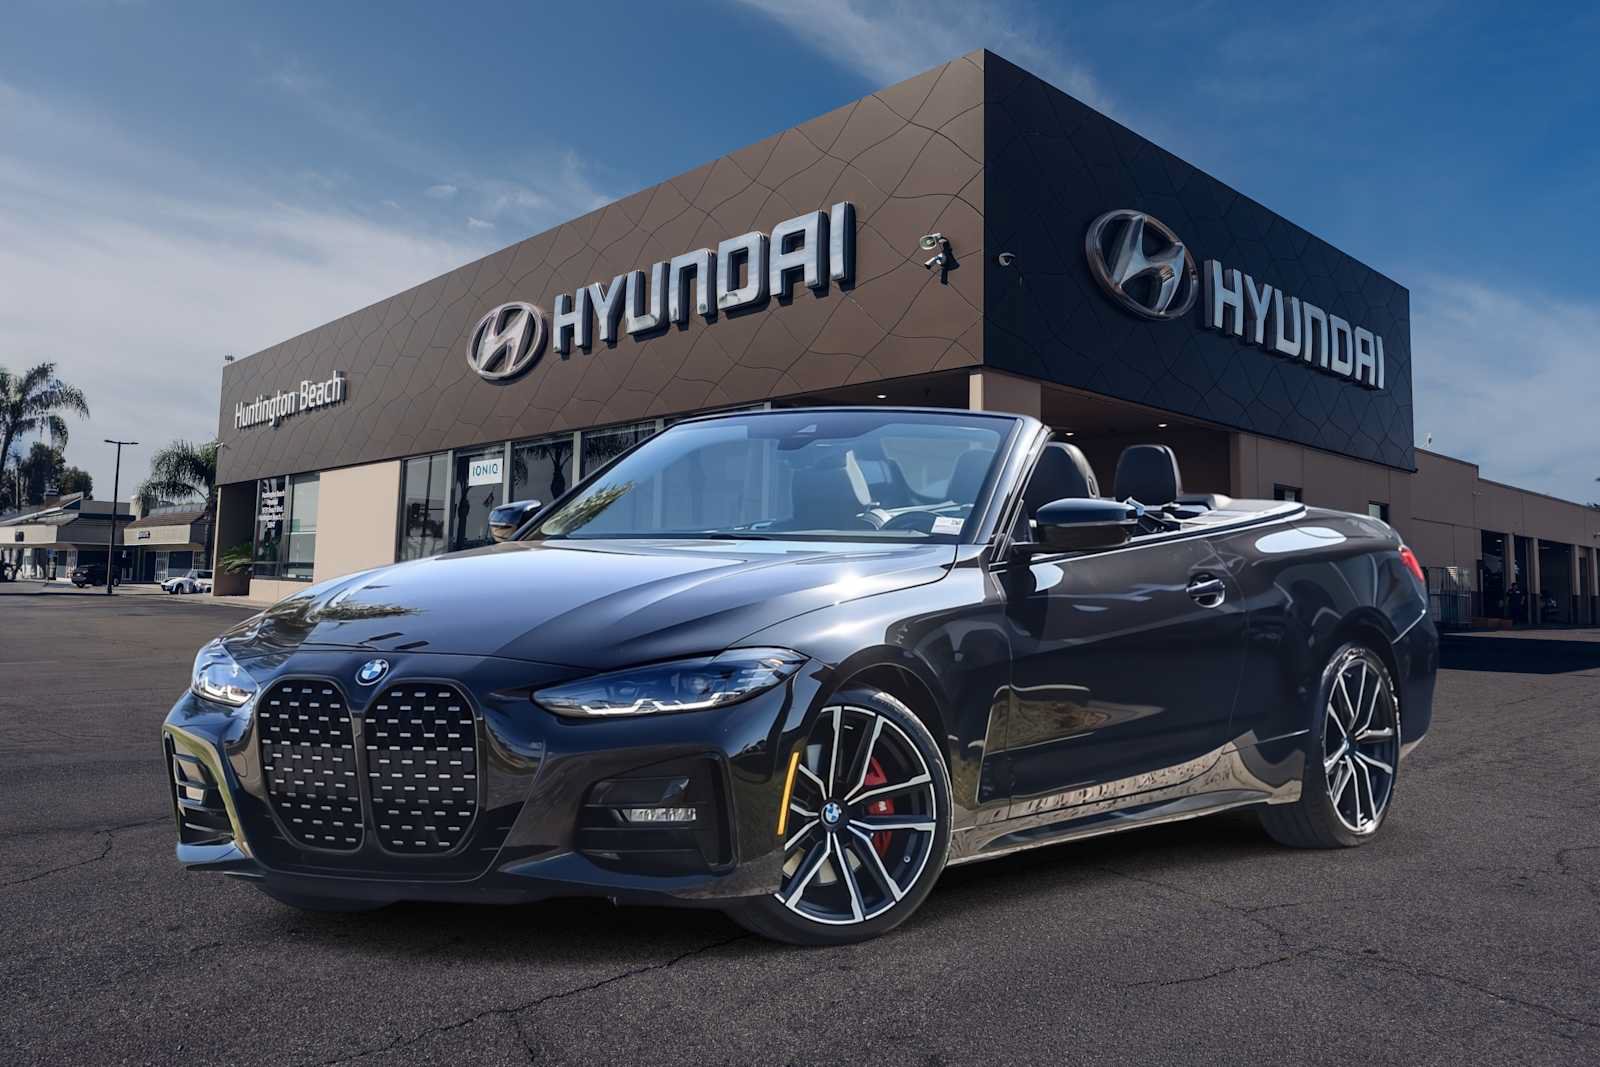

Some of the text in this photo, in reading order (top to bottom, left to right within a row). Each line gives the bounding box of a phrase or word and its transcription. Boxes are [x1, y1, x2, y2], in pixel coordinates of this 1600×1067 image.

[552, 201, 851, 354] HYUNDAI
[1207, 259, 1385, 390] HYUNDAI
[234, 369, 344, 430] Huntington Beach
[472, 463, 499, 477] IONIQ
